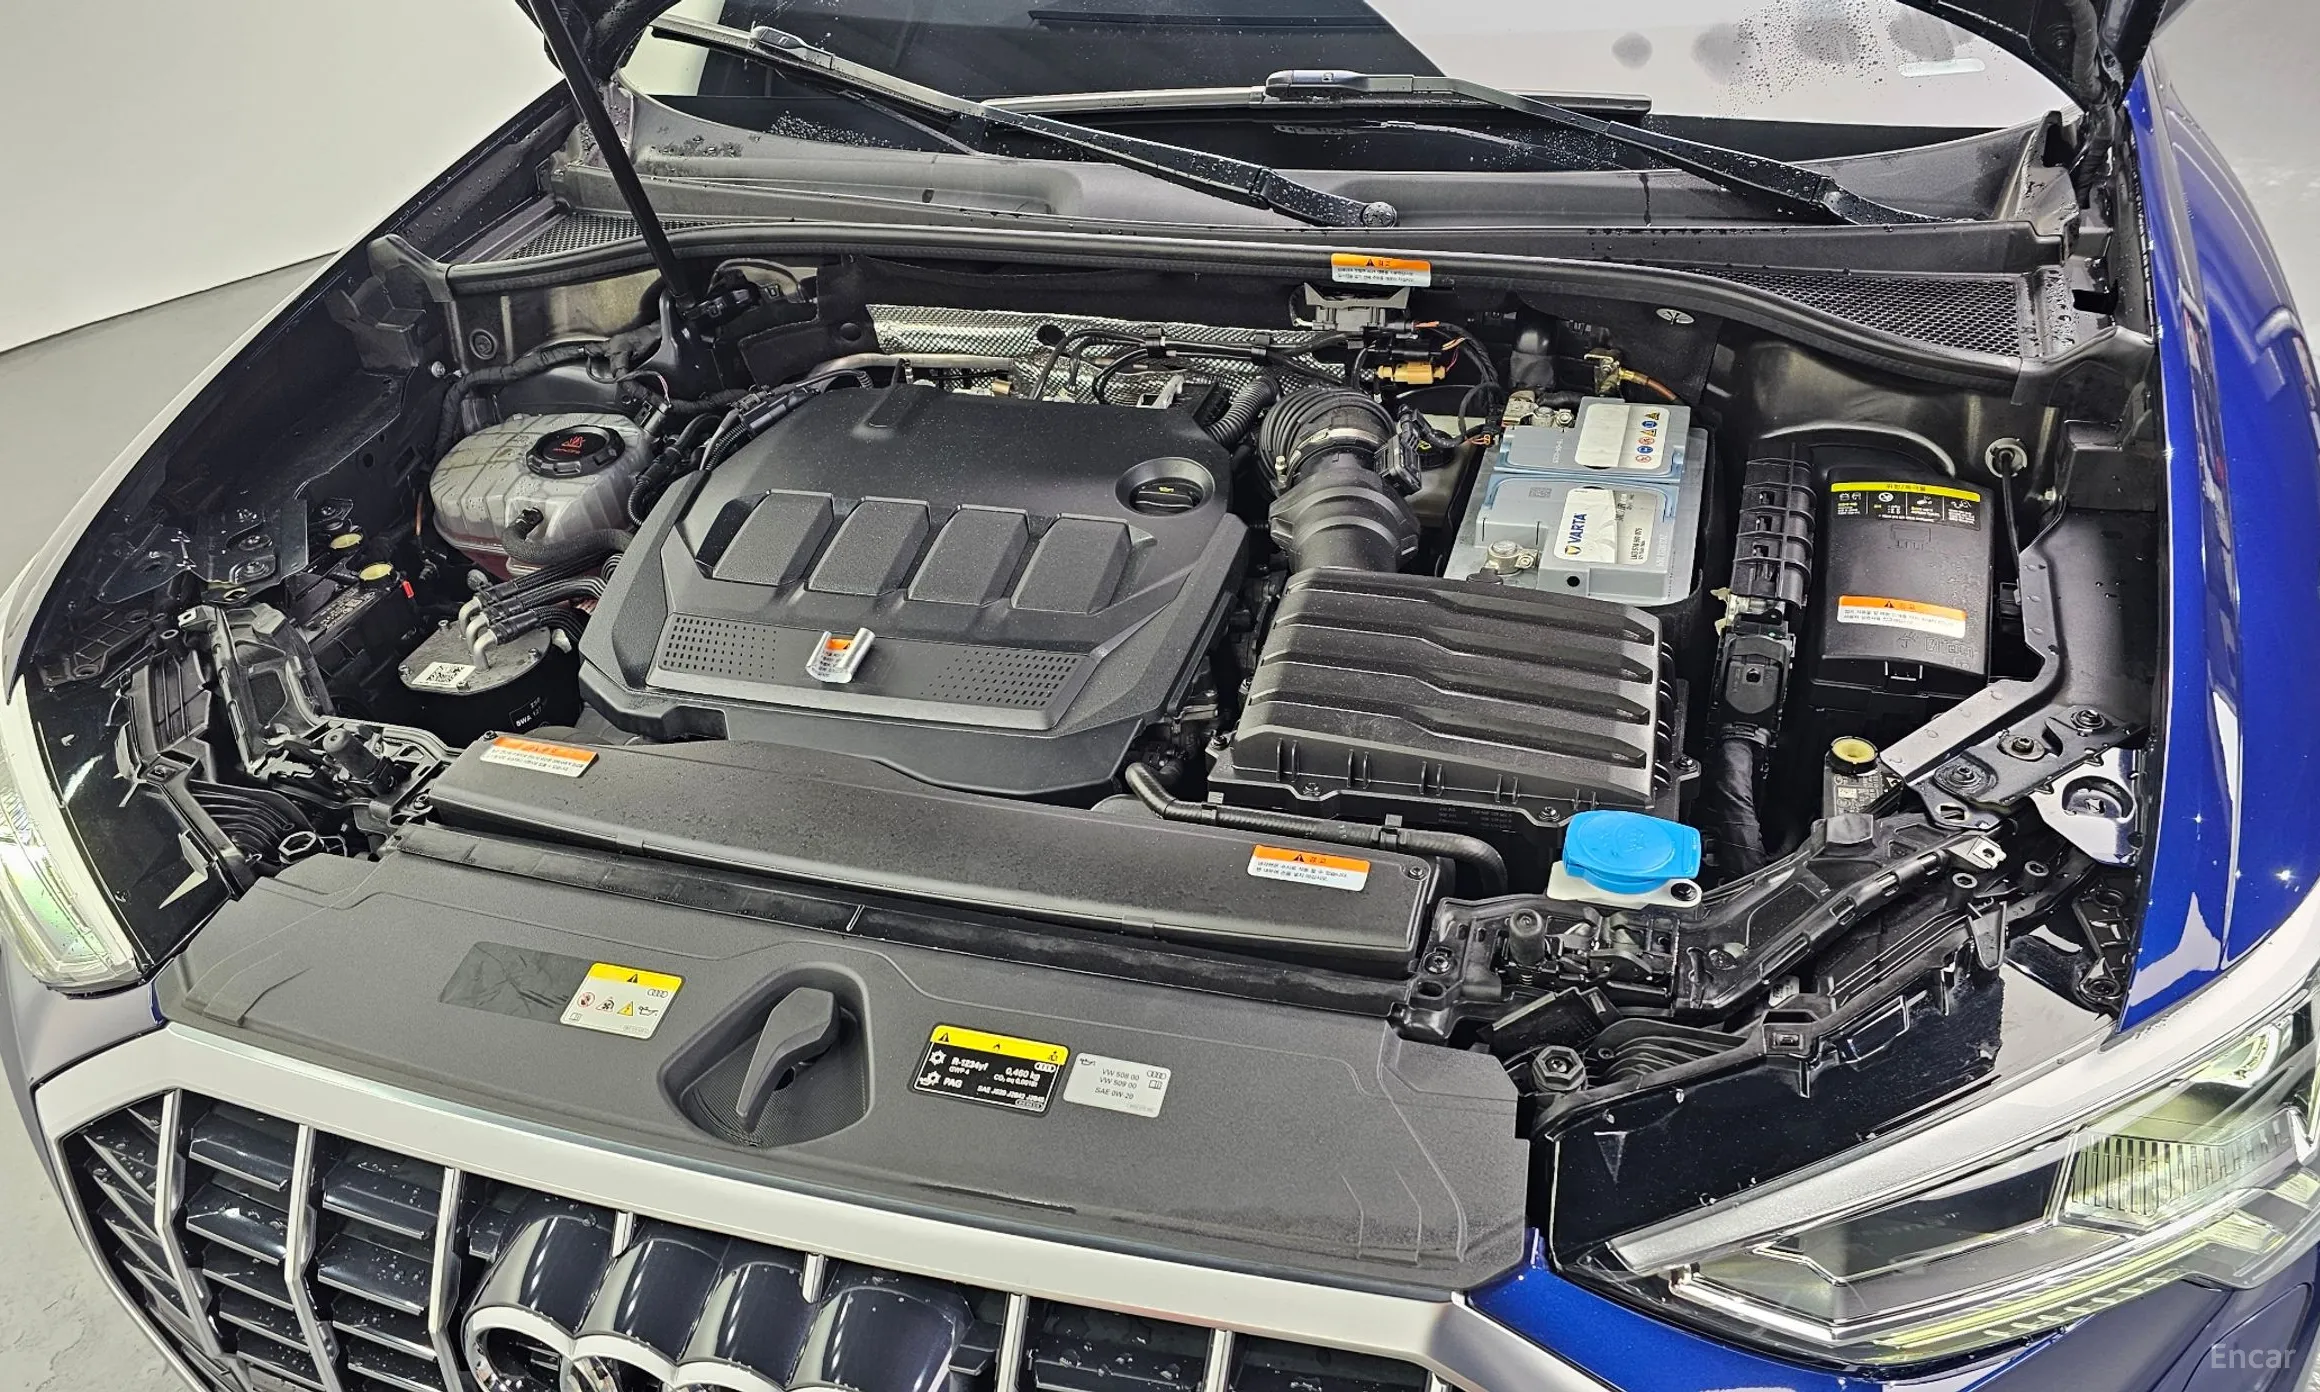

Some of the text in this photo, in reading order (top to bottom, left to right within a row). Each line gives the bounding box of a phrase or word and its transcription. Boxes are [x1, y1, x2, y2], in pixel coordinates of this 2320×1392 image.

[1567, 513, 1588, 545] VARTA
[951, 1056, 989, 1072] R-1234yf
[1029, 1070, 1041, 1082] kg
[1102, 1068, 1140, 1081] VW 508 00
[942, 1076, 963, 1089] PAG
[1100, 1076, 1137, 1089] VW 509 00
[1094, 1087, 1110, 1096] SAE
